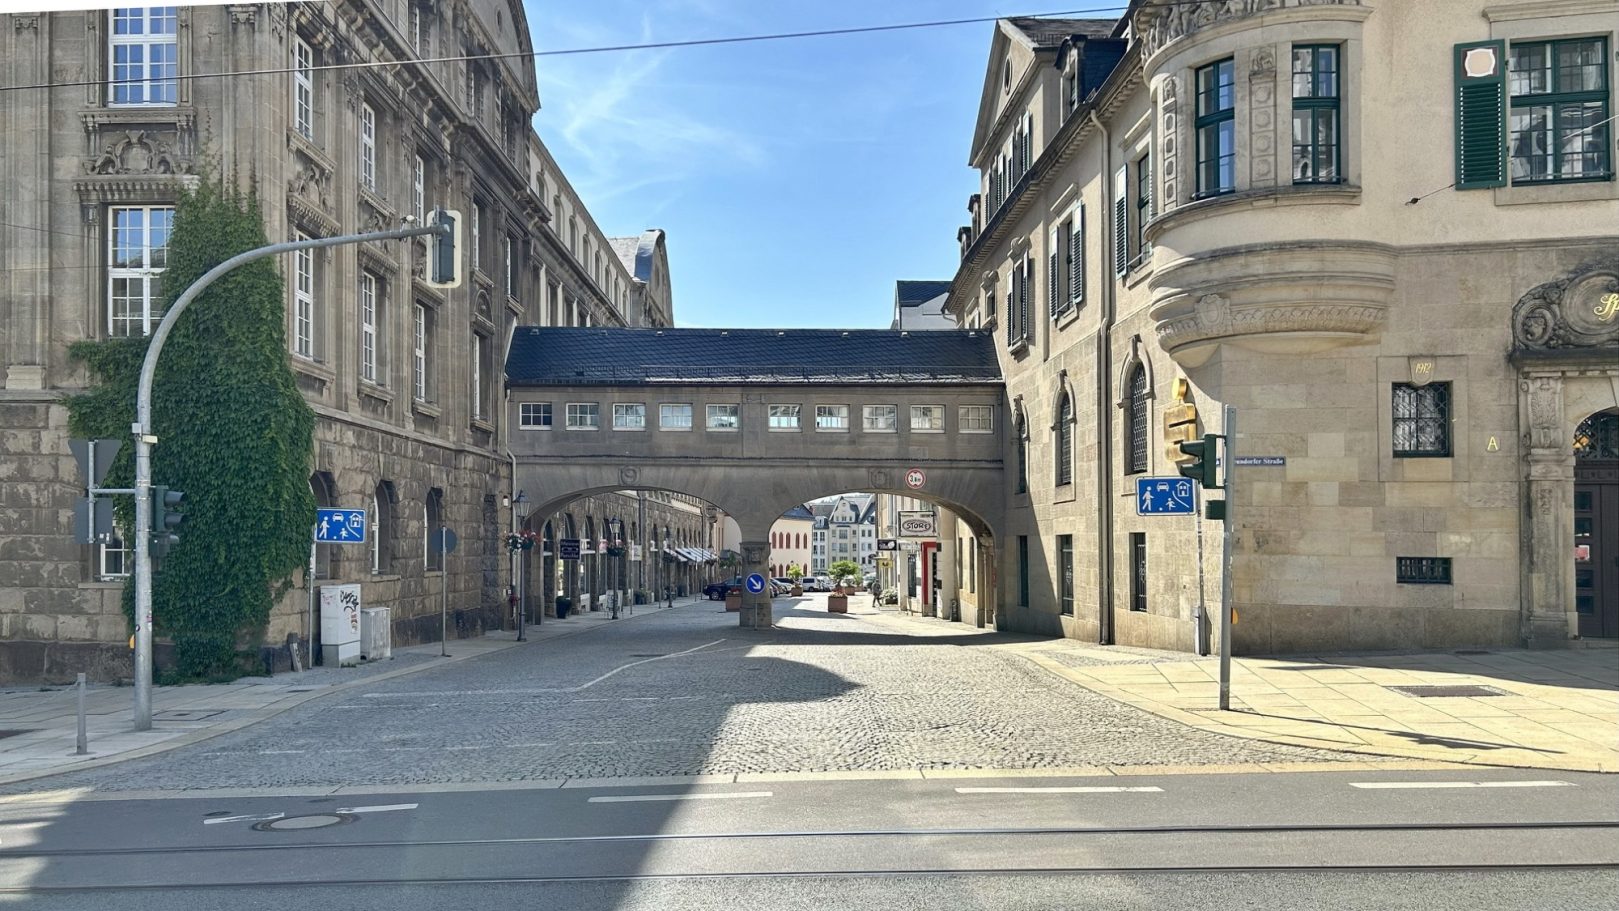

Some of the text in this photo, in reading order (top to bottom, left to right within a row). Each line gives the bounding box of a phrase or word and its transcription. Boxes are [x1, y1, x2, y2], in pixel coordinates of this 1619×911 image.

[1415, 362, 1432, 375] 1912
[1487, 436, 1499, 451] A
[906, 522, 928, 530] STORE
